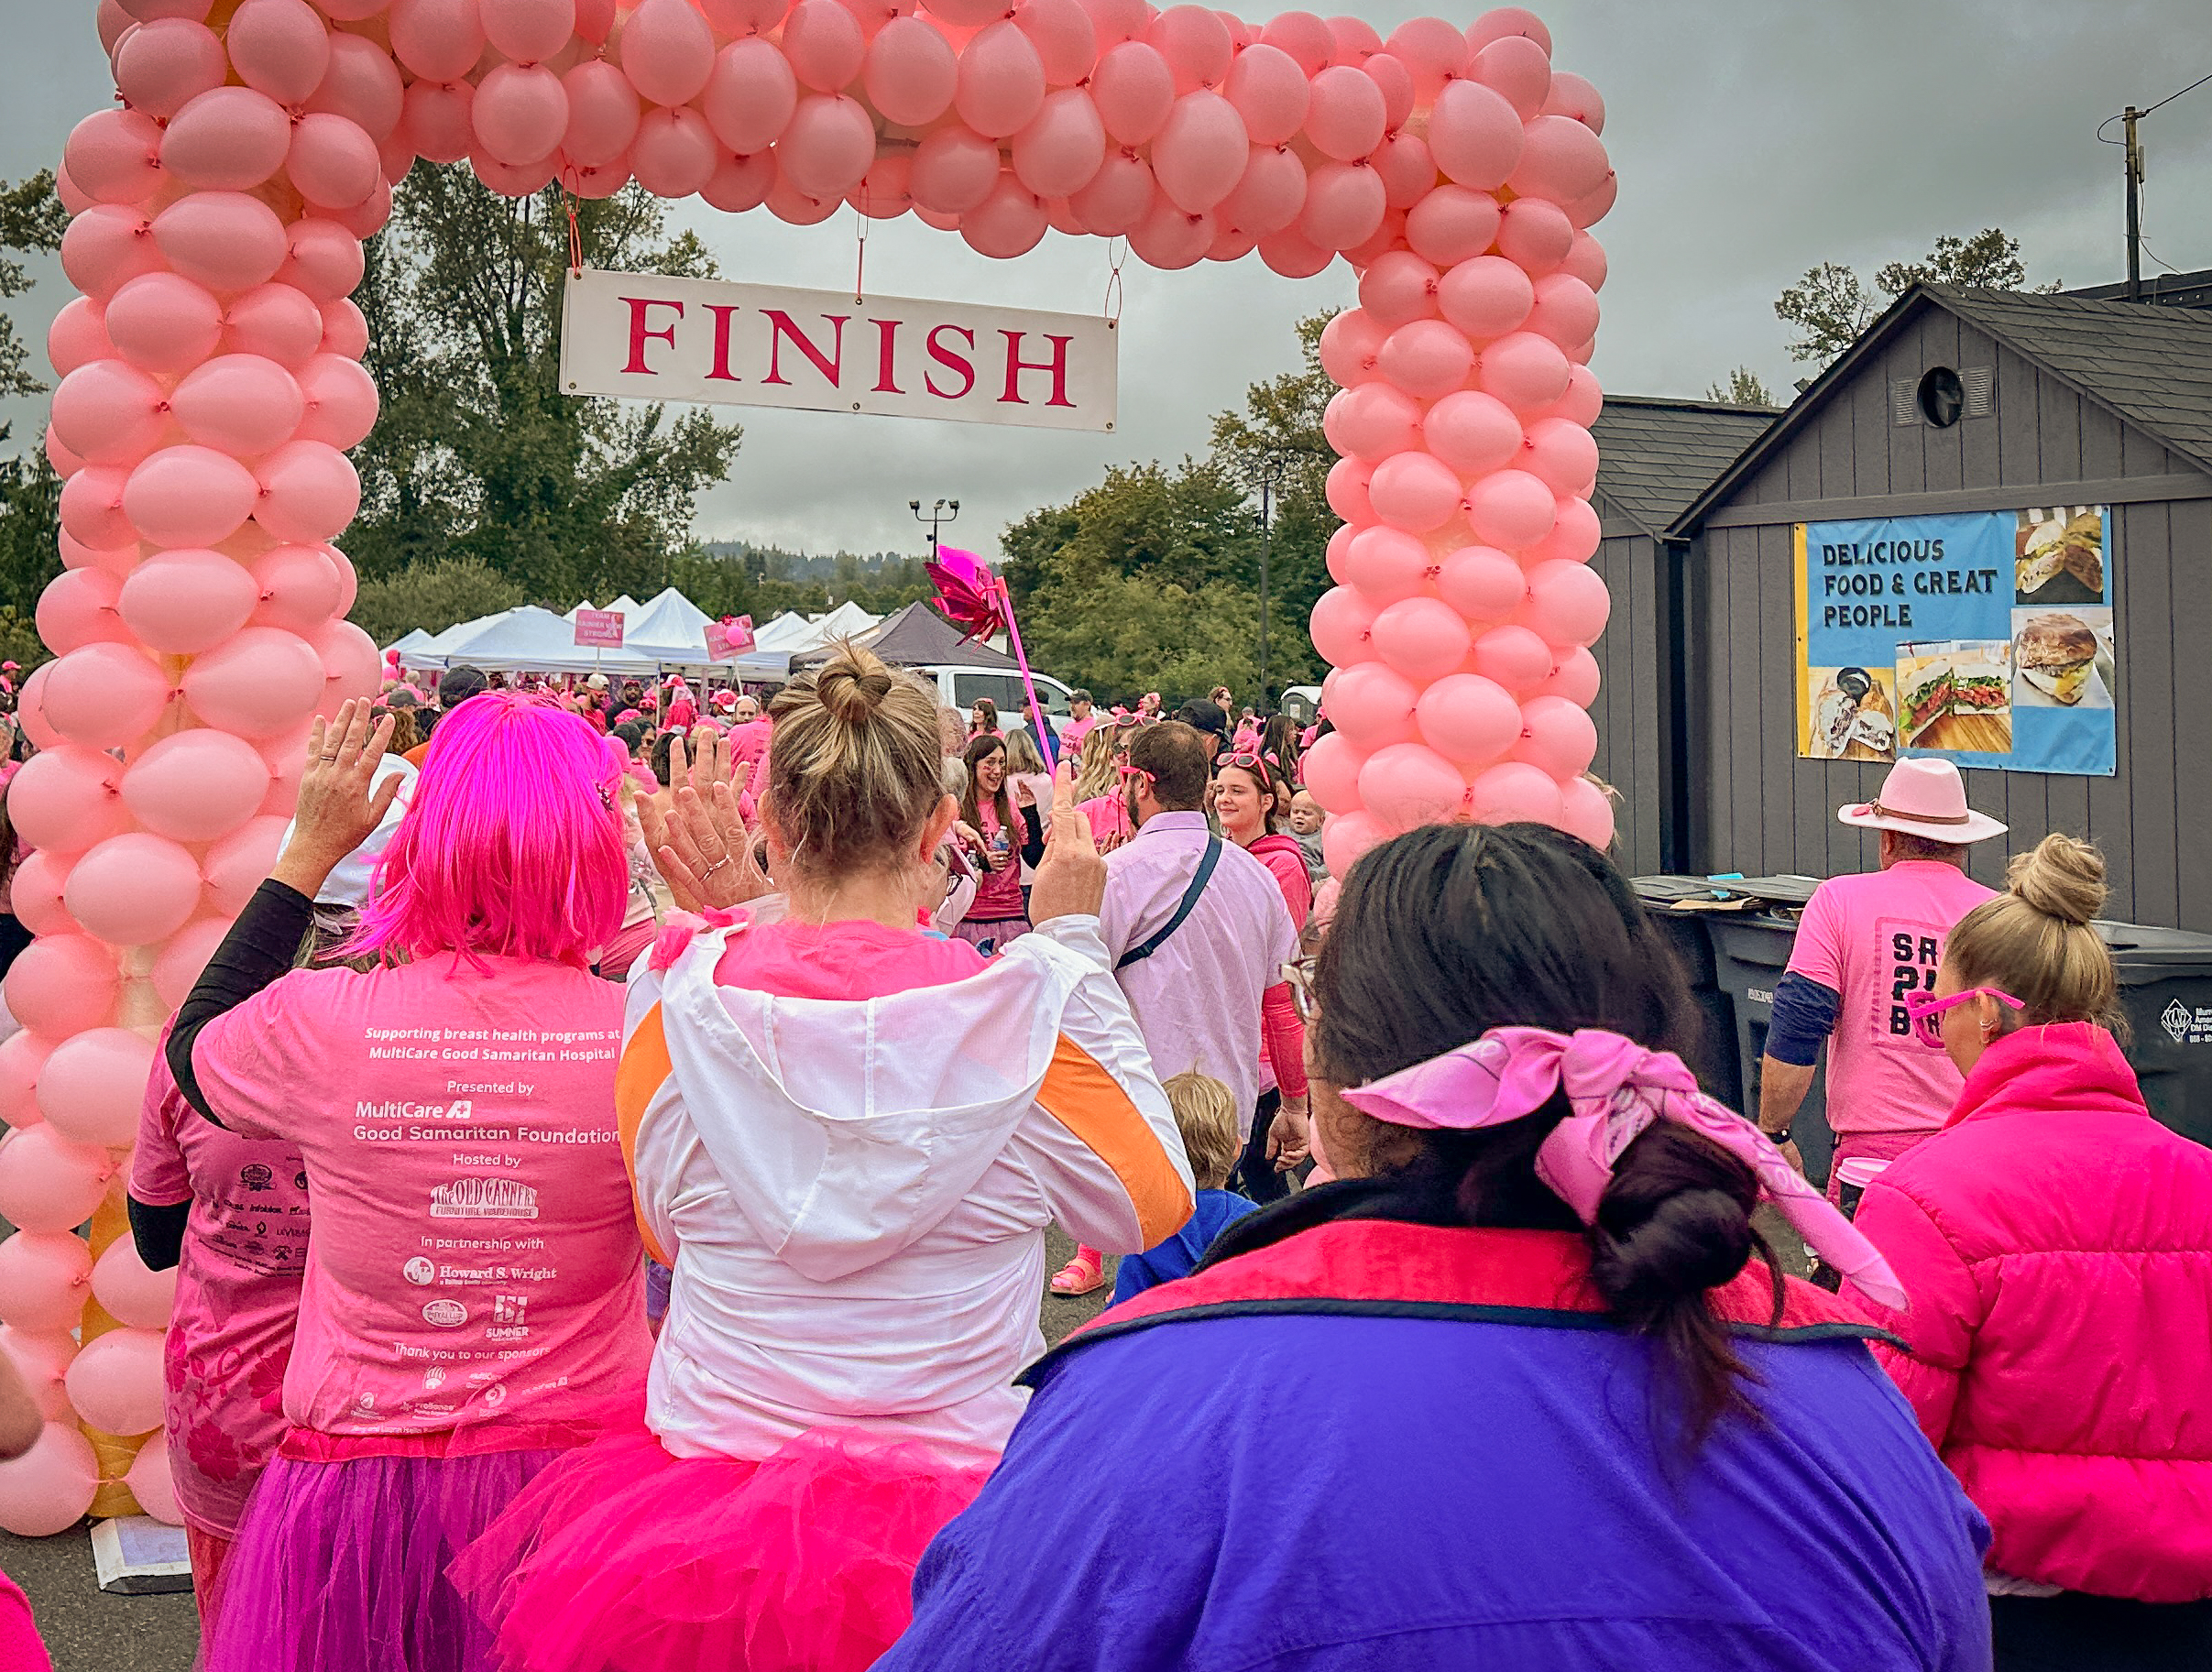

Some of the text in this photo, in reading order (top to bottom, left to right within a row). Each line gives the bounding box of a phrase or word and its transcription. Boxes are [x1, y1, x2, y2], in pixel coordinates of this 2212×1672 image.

[618, 296, 1077, 408] FINISH
[1822, 539, 1944, 567] DELICIOUS
[1823, 569, 1998, 596] FOOD & GREAT
[1823, 604, 1912, 628] PEOPLE
[365, 1027, 620, 1045] Supporting breast health programs at
[368, 1047, 616, 1063] MultiCare Good Samaritan Hospital
[446, 1080, 535, 1096] Presented by
[356, 1100, 443, 1119] MultiCare
[354, 1125, 620, 1143] Good Samaritan Foundation
[453, 1153, 521, 1168] Hosted by
[455, 1179, 484, 1206] OLD
[421, 1236, 544, 1251] In partnership with
[439, 1265, 557, 1282] Howard S. Wright
[485, 1327, 530, 1339] SUMNER
[393, 1342, 550, 1361] Thank you to our sponsors
